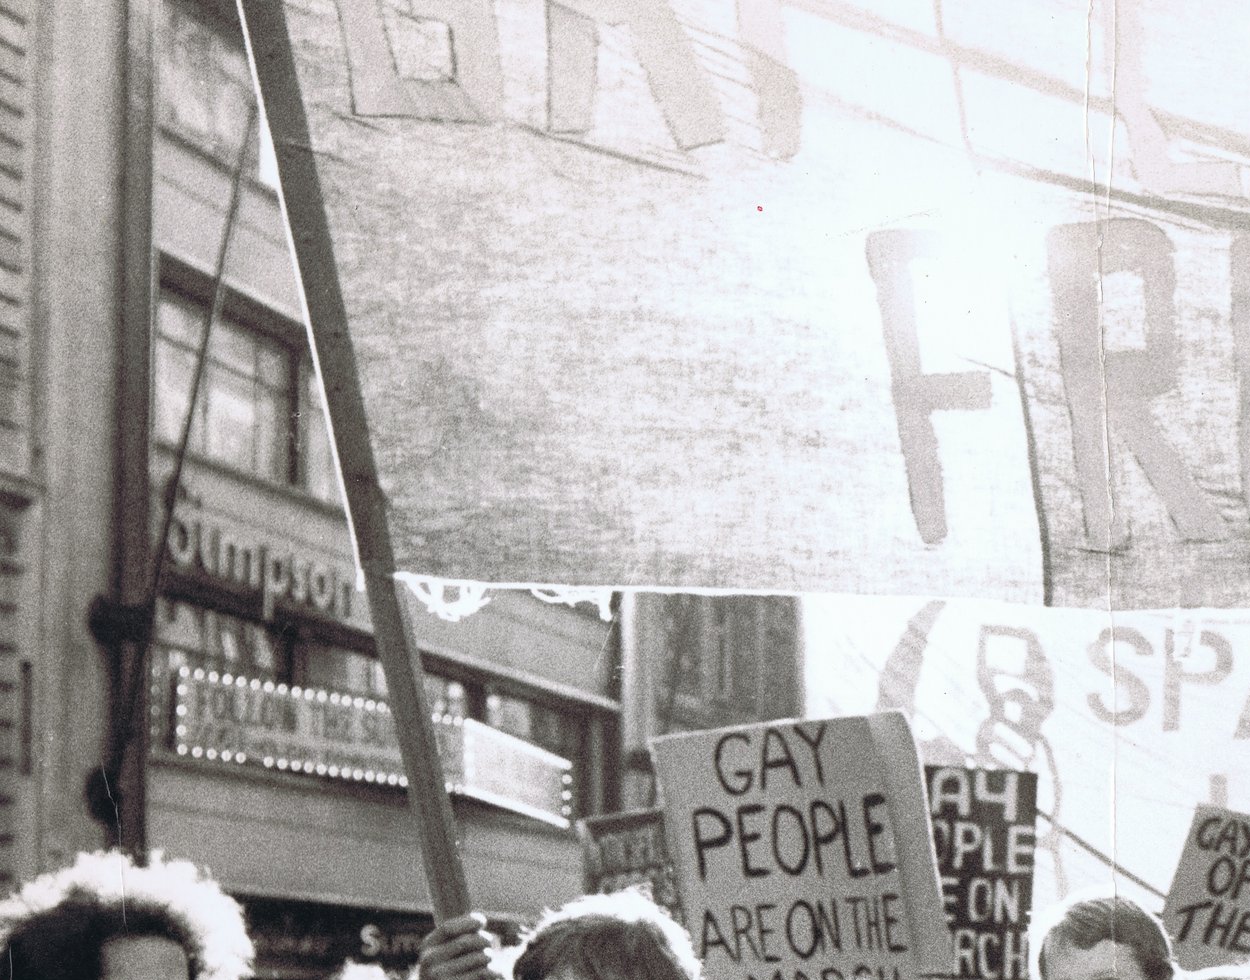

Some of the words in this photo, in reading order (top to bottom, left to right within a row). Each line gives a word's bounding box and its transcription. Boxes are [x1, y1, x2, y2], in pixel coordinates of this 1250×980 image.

[714, 723, 828, 796] GAY
[930, 767, 1019, 823] AY
[693, 793, 896, 882] PEOPLE
[931, 818, 1036, 876] OPLE
[700, 908, 782, 965] ARE
[786, 898, 843, 961] ON
[845, 893, 908, 953] THE
[968, 876, 1020, 925] ON
